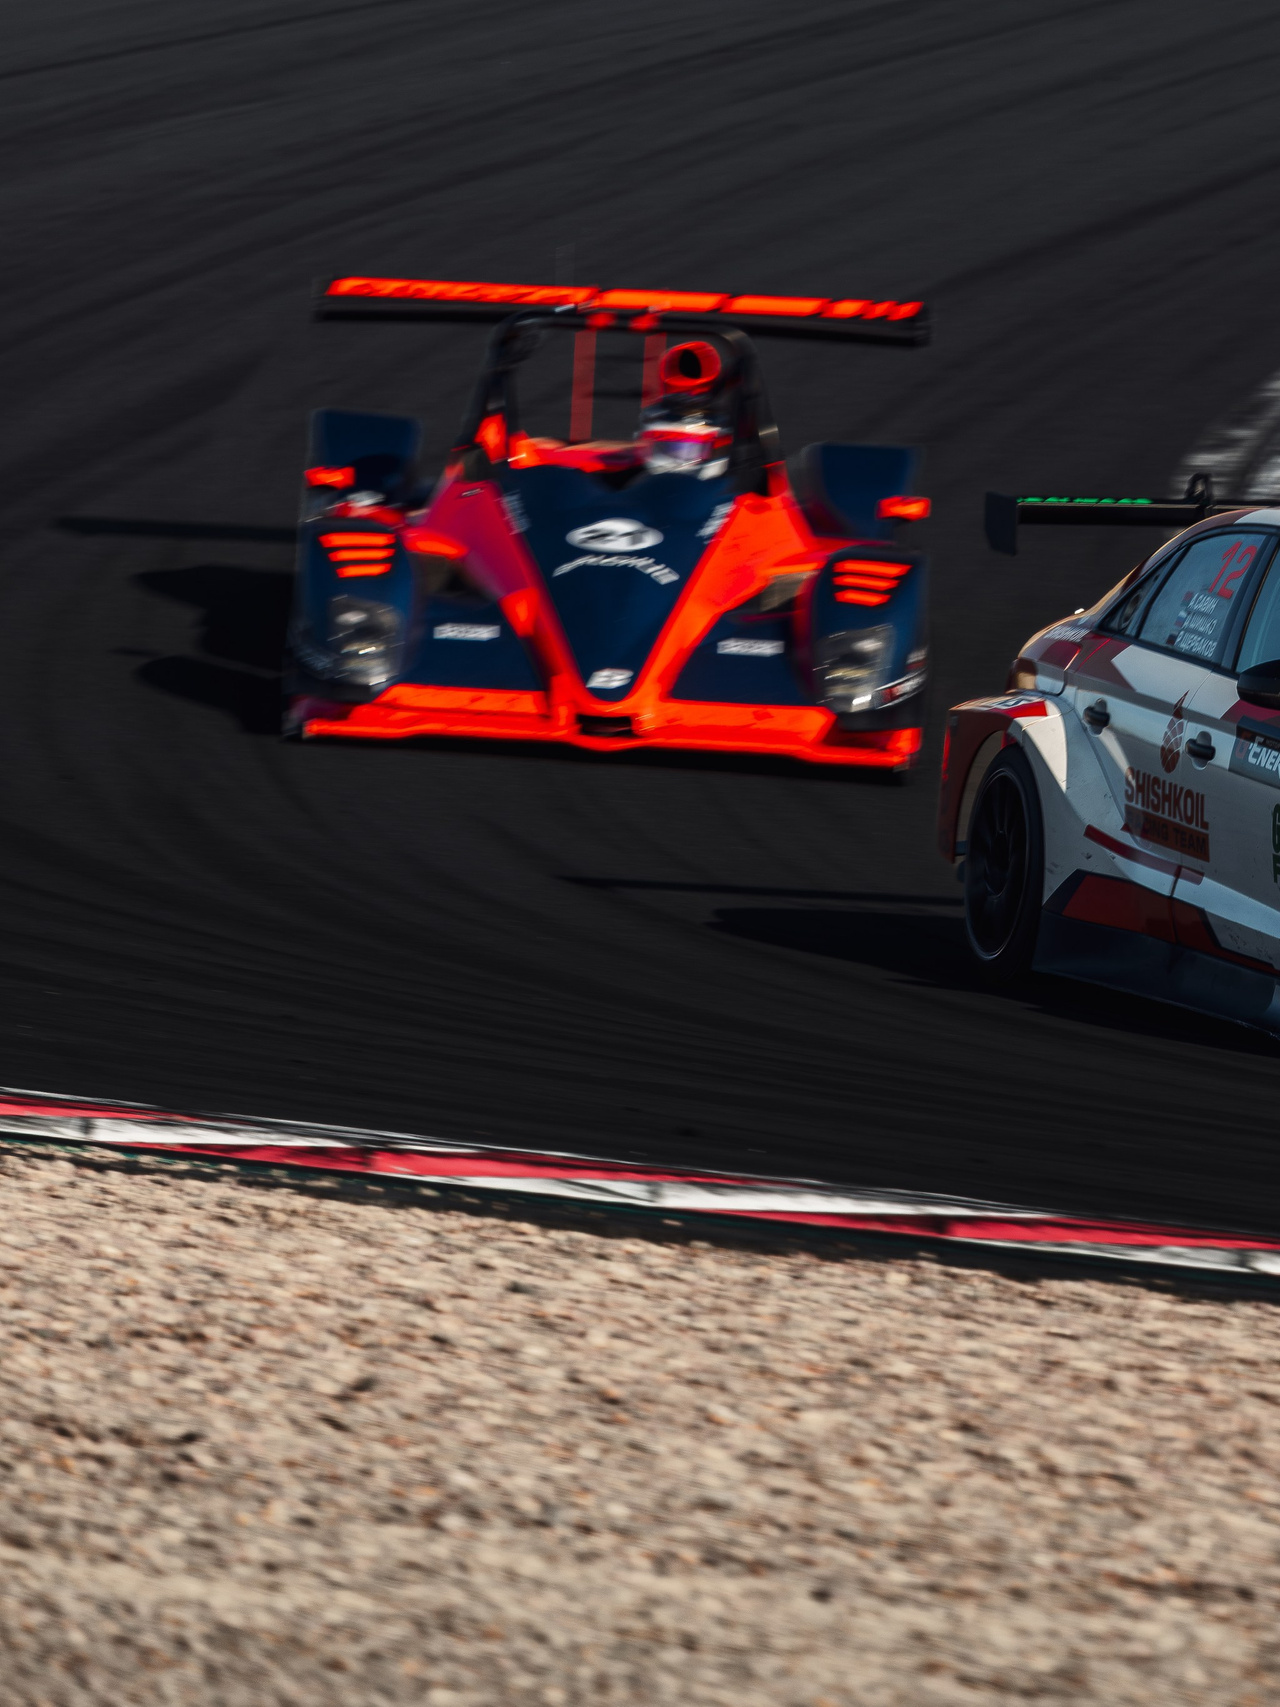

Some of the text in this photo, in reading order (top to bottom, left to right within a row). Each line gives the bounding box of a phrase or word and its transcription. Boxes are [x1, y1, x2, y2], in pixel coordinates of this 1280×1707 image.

[1208, 541, 1257, 599] 12
[1124, 767, 1209, 831] SHISHKOIL
[1173, 827, 1206, 854] TEAM
